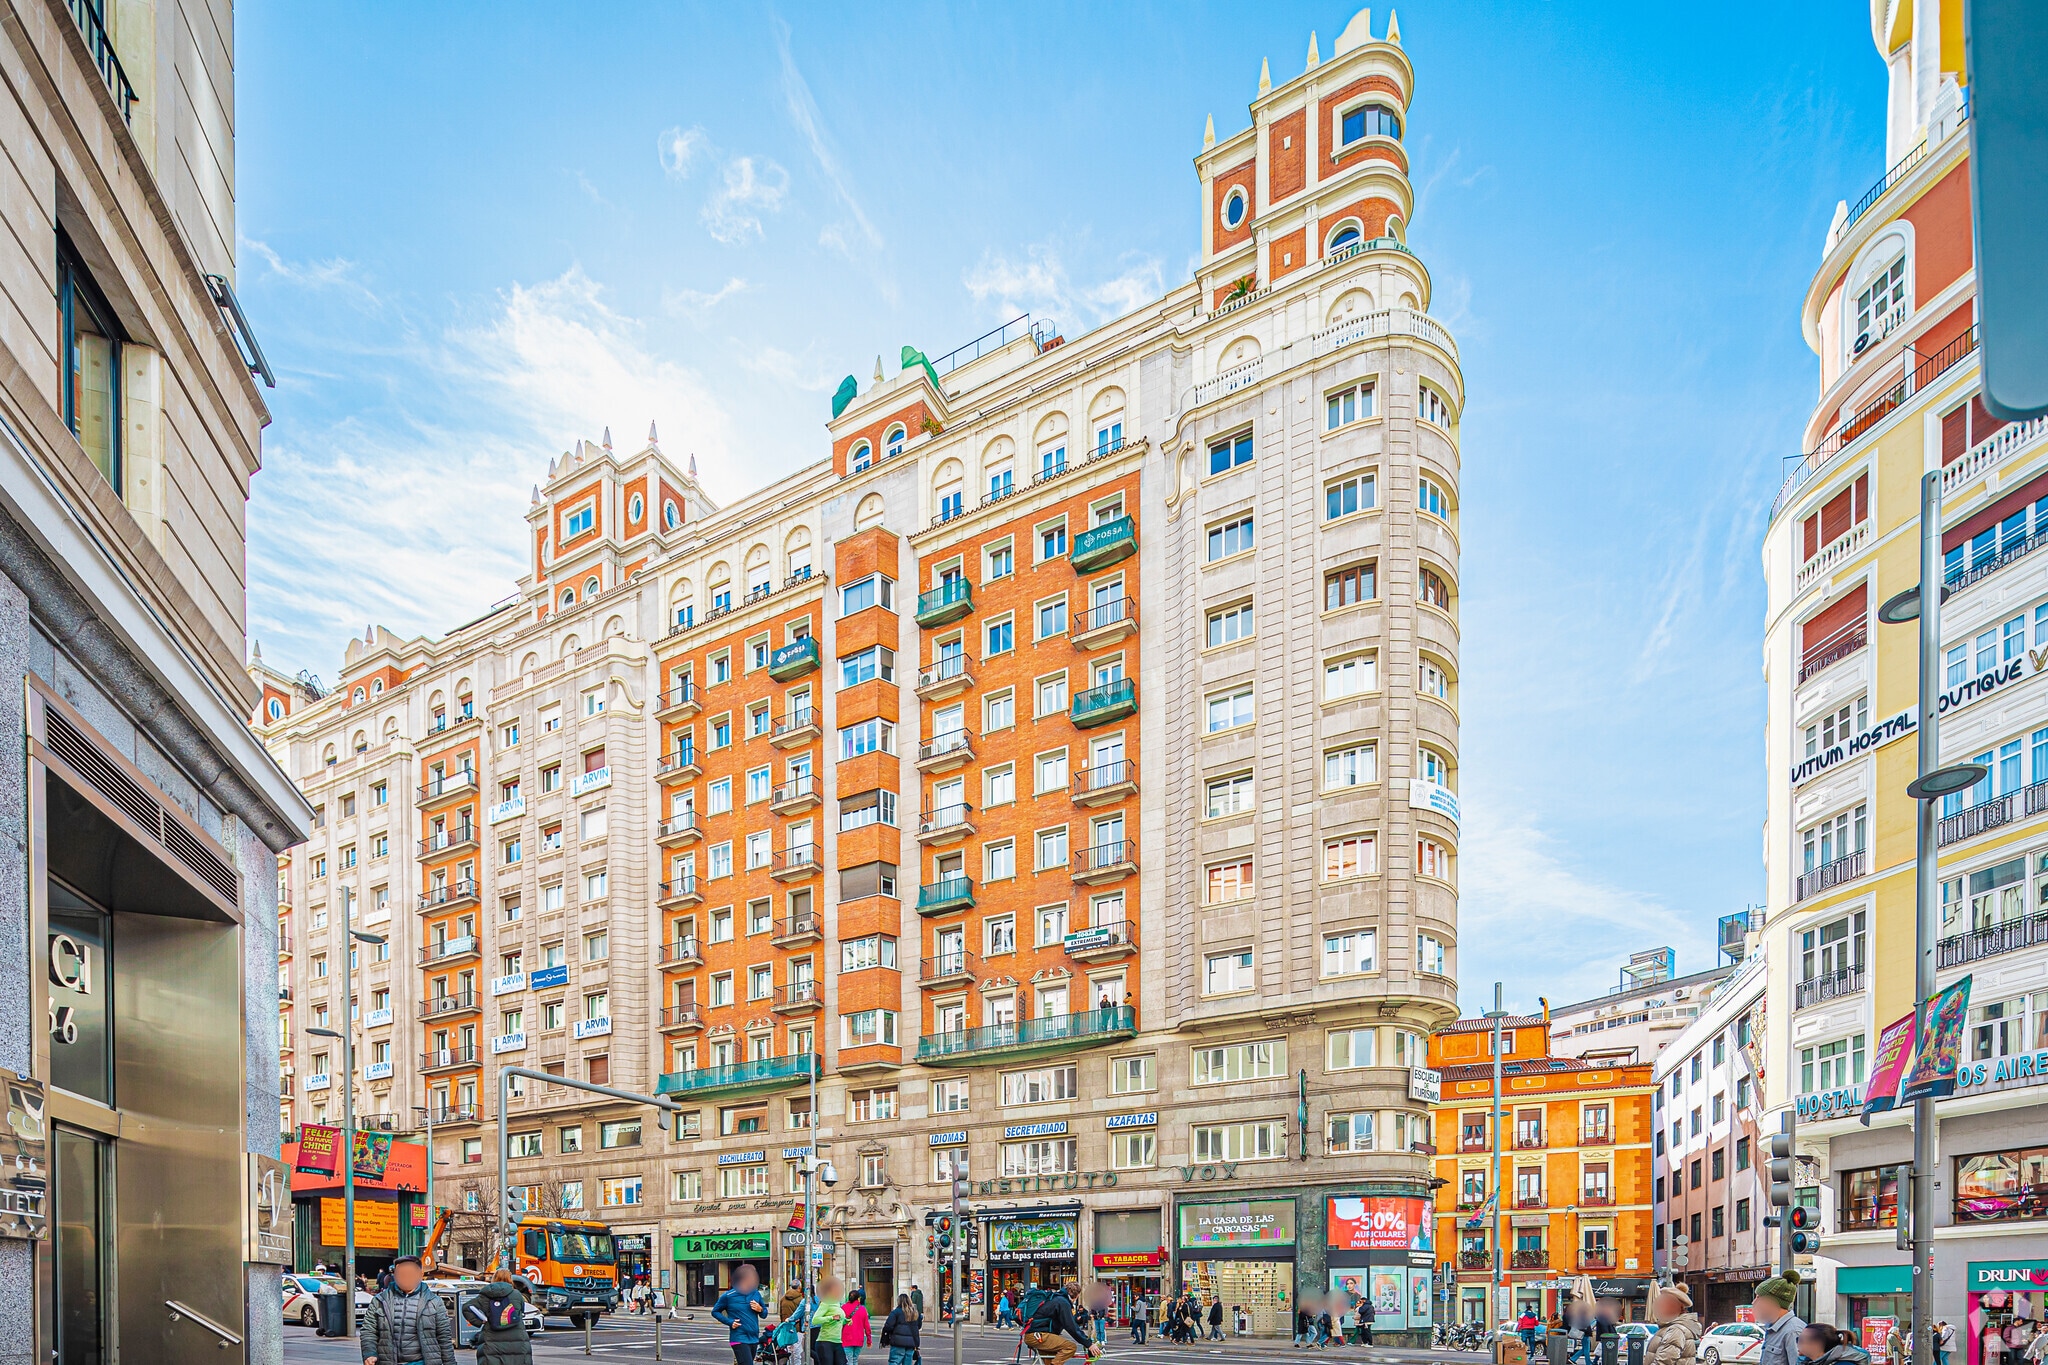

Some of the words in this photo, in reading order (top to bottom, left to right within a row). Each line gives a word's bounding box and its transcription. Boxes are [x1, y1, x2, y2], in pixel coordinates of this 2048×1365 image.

[1096, 526, 1123, 541] FOSSA
[1792, 745, 1844, 783] VITIUM
[1849, 712, 1918, 756] HOSTAL
[1939, 658, 2023, 713] OUTIQUE
[582, 767, 609, 786] ARVIN
[499, 799, 523, 814] ARVIN
[585, 1017, 609, 1030] ARVIN
[502, 1033, 524, 1045] ARVIN
[372, 1062, 390, 1073] ARVIN
[1414, 1069, 1440, 1084] ESCUELA
[1796, 1087, 1864, 1116] HOSTAL
[1993, 1052, 2048, 1082] AIRE
[1414, 1086, 1439, 1102] TURISMO
[1107, 1113, 1155, 1127] AZAFATAS
[305, 1128, 334, 1139] FELIZ
[1006, 1122, 1066, 1137] SECRETARIADO
[930, 1132, 965, 1144] IDIOMAS
[303, 1142, 332, 1153] CHINO
[784, 1147, 813, 1157] TURISM
[719, 1151, 763, 1164] BACHILLERATO
[1180, 1162, 1239, 1182] VOX
[968, 1172, 1118, 1196] INSTITUTO
[1198, 1217, 1211, 1226] LA
[1213, 1216, 1238, 1225] CASA
[1240, 1215, 1253, 1224] DE
[1255, 1214, 1275, 1223] LAS
[1351, 1211, 1406, 1230] -50%
[1211, 1224, 1260, 1234] CARCASAS
[1354, 1230, 1407, 1238] AURICULARES
[687, 1240, 702, 1252] La
[704, 1238, 753, 1252] Toscana
[990, 1252, 1002, 1260] bar
[1002, 1251, 1011, 1259] de
[1012, 1251, 1031, 1261] tapas
[1033, 1250, 1075, 1259] restaurante
[1978, 1268, 2031, 1282] DRUNI
